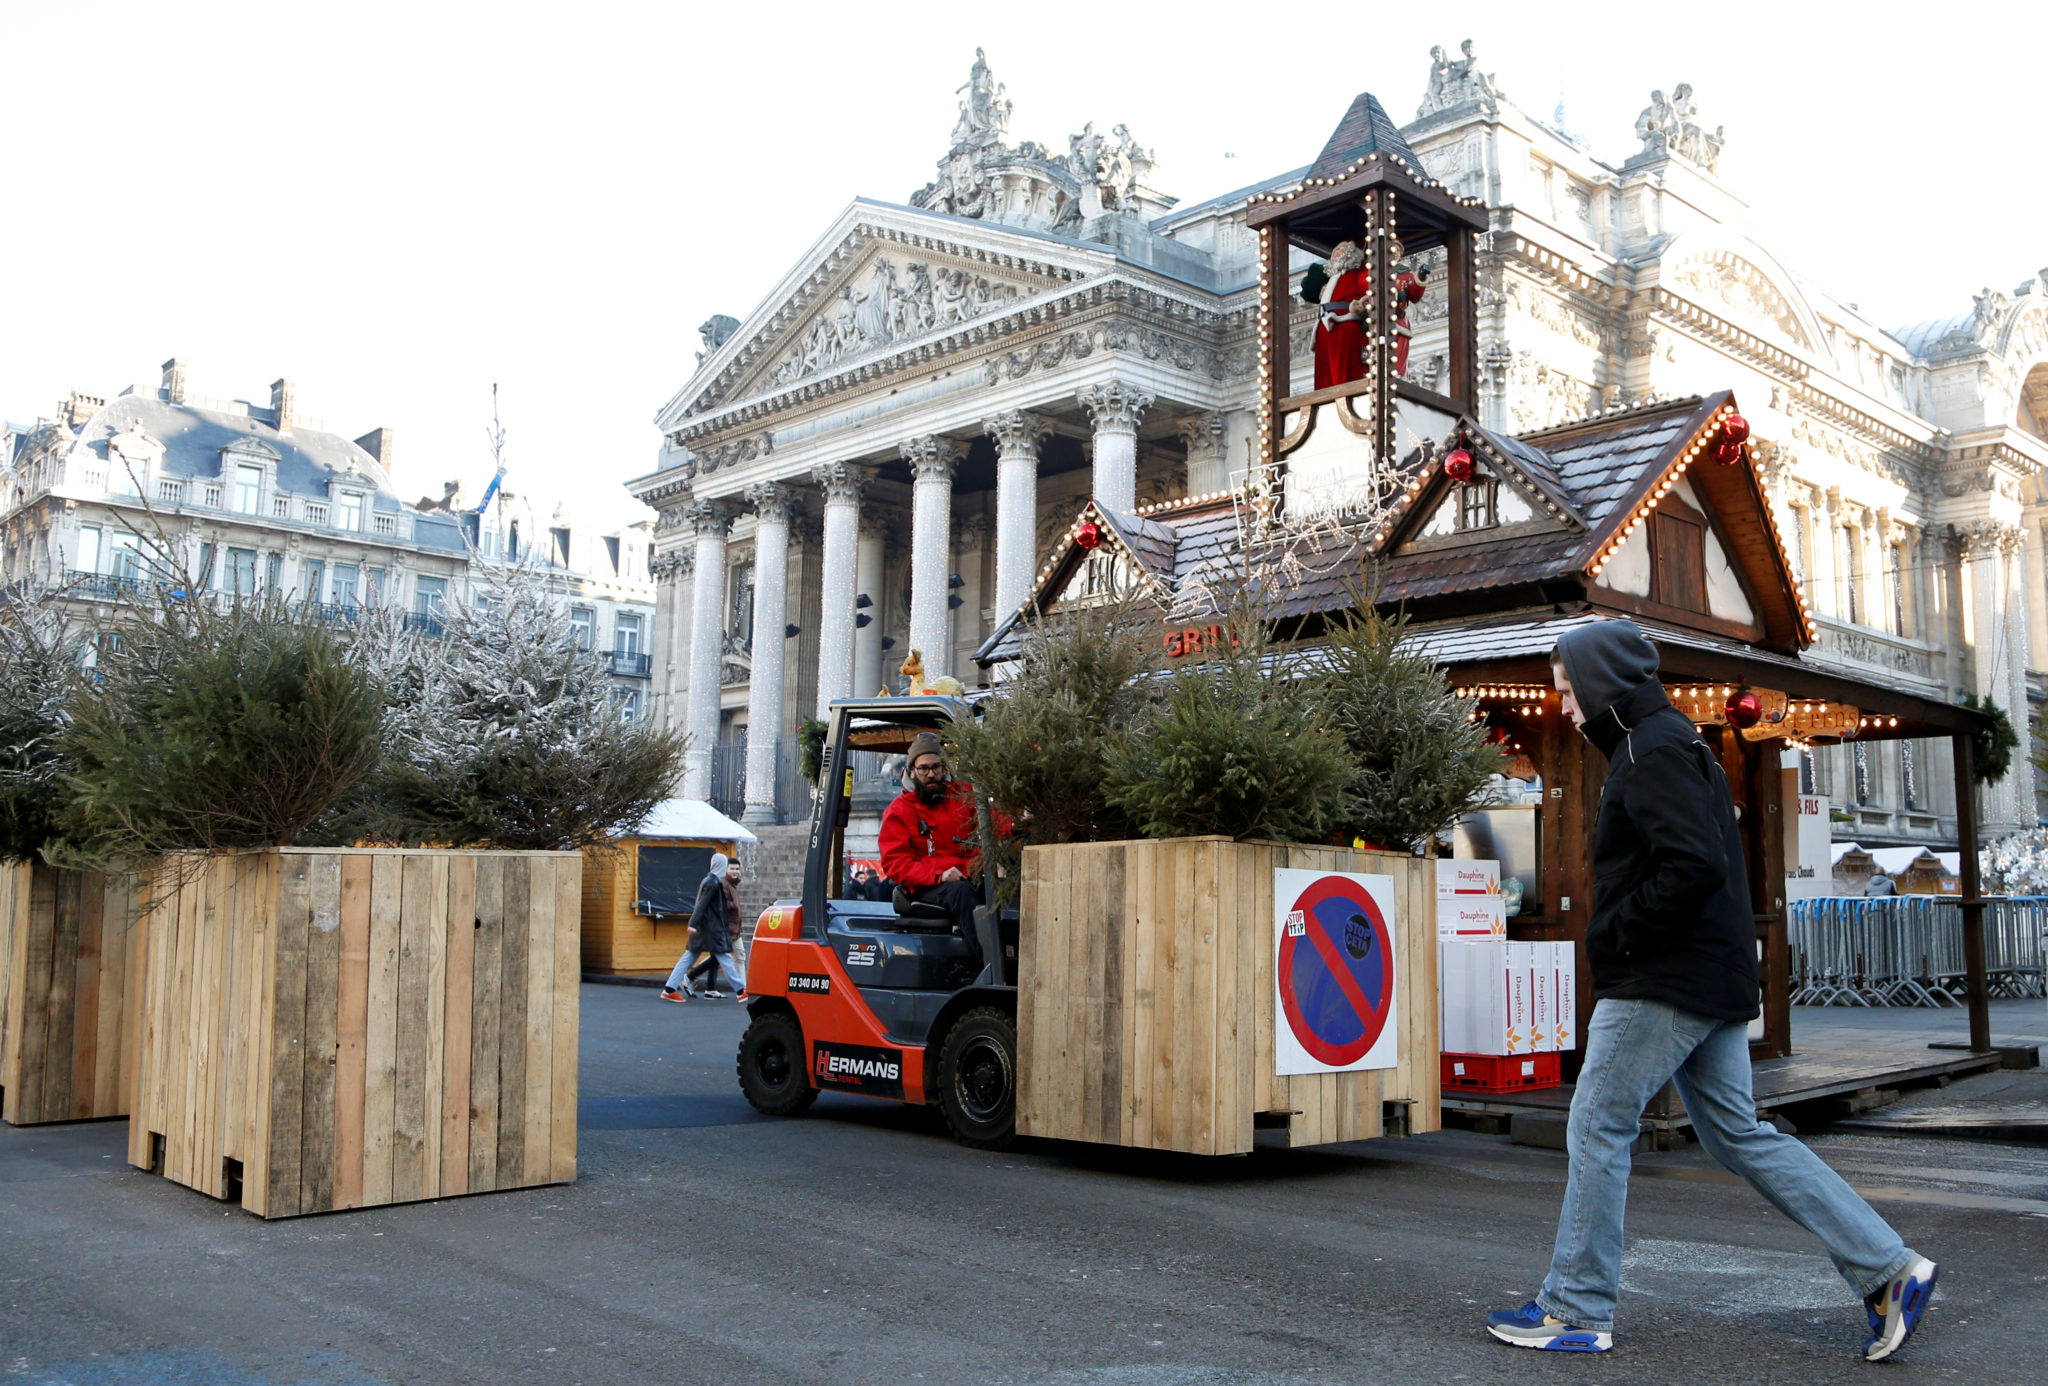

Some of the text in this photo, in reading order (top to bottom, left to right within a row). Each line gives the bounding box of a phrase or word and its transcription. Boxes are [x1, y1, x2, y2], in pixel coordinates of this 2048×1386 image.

[1804, 799, 1819, 815] FILS
[1458, 870, 1485, 882] Dauphine
[1288, 912, 1303, 924] STOP
[1460, 910, 1489, 922] Dauphine
[1346, 921, 1371, 940] STOP
[1346, 933, 1368, 953] CETA
[846, 951, 876, 966] 25
[789, 977, 830, 990] 03 340 04 90
[1515, 976, 1523, 1024] Dauphine
[1538, 976, 1546, 1023] Dauphine
[816, 1050, 899, 1080] HERMANS
